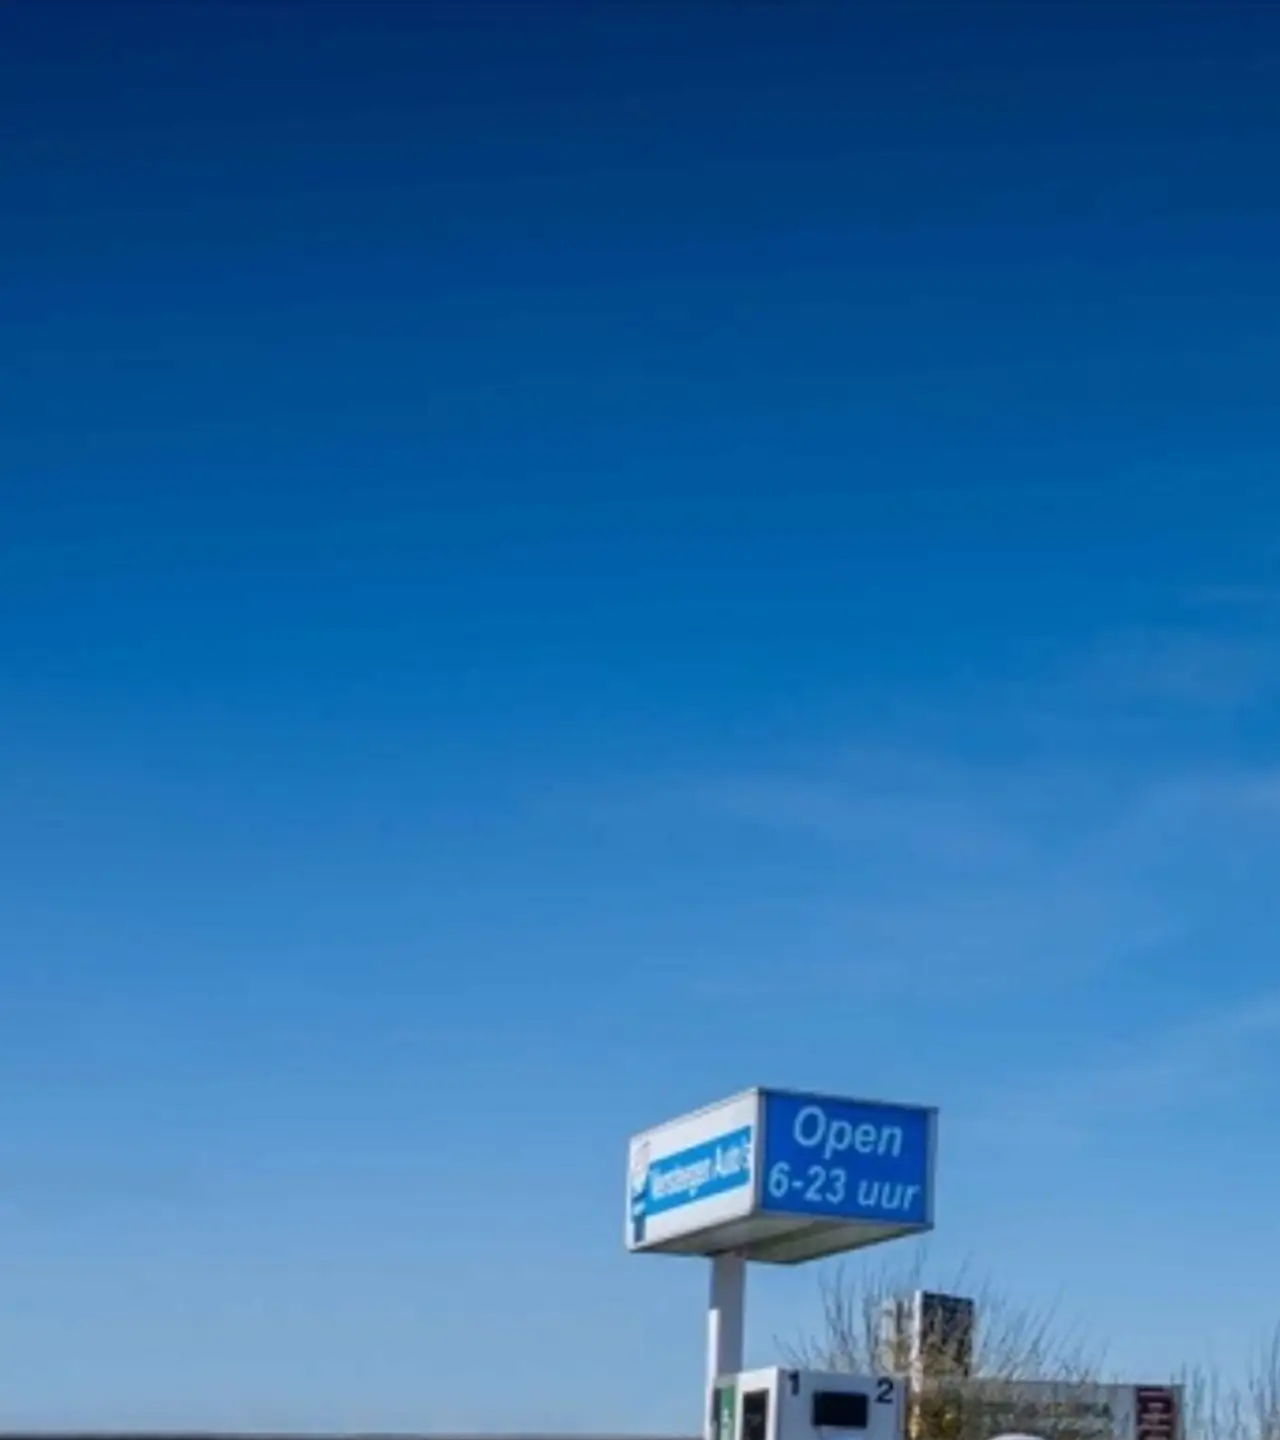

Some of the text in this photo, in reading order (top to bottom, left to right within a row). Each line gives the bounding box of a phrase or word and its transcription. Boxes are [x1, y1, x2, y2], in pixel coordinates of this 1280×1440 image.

[792, 1105, 903, 1160] Open
[767, 1160, 923, 1210] 6-23 uur
[788, 1371, 799, 1396] 1
[875, 1377, 894, 1404] 2
